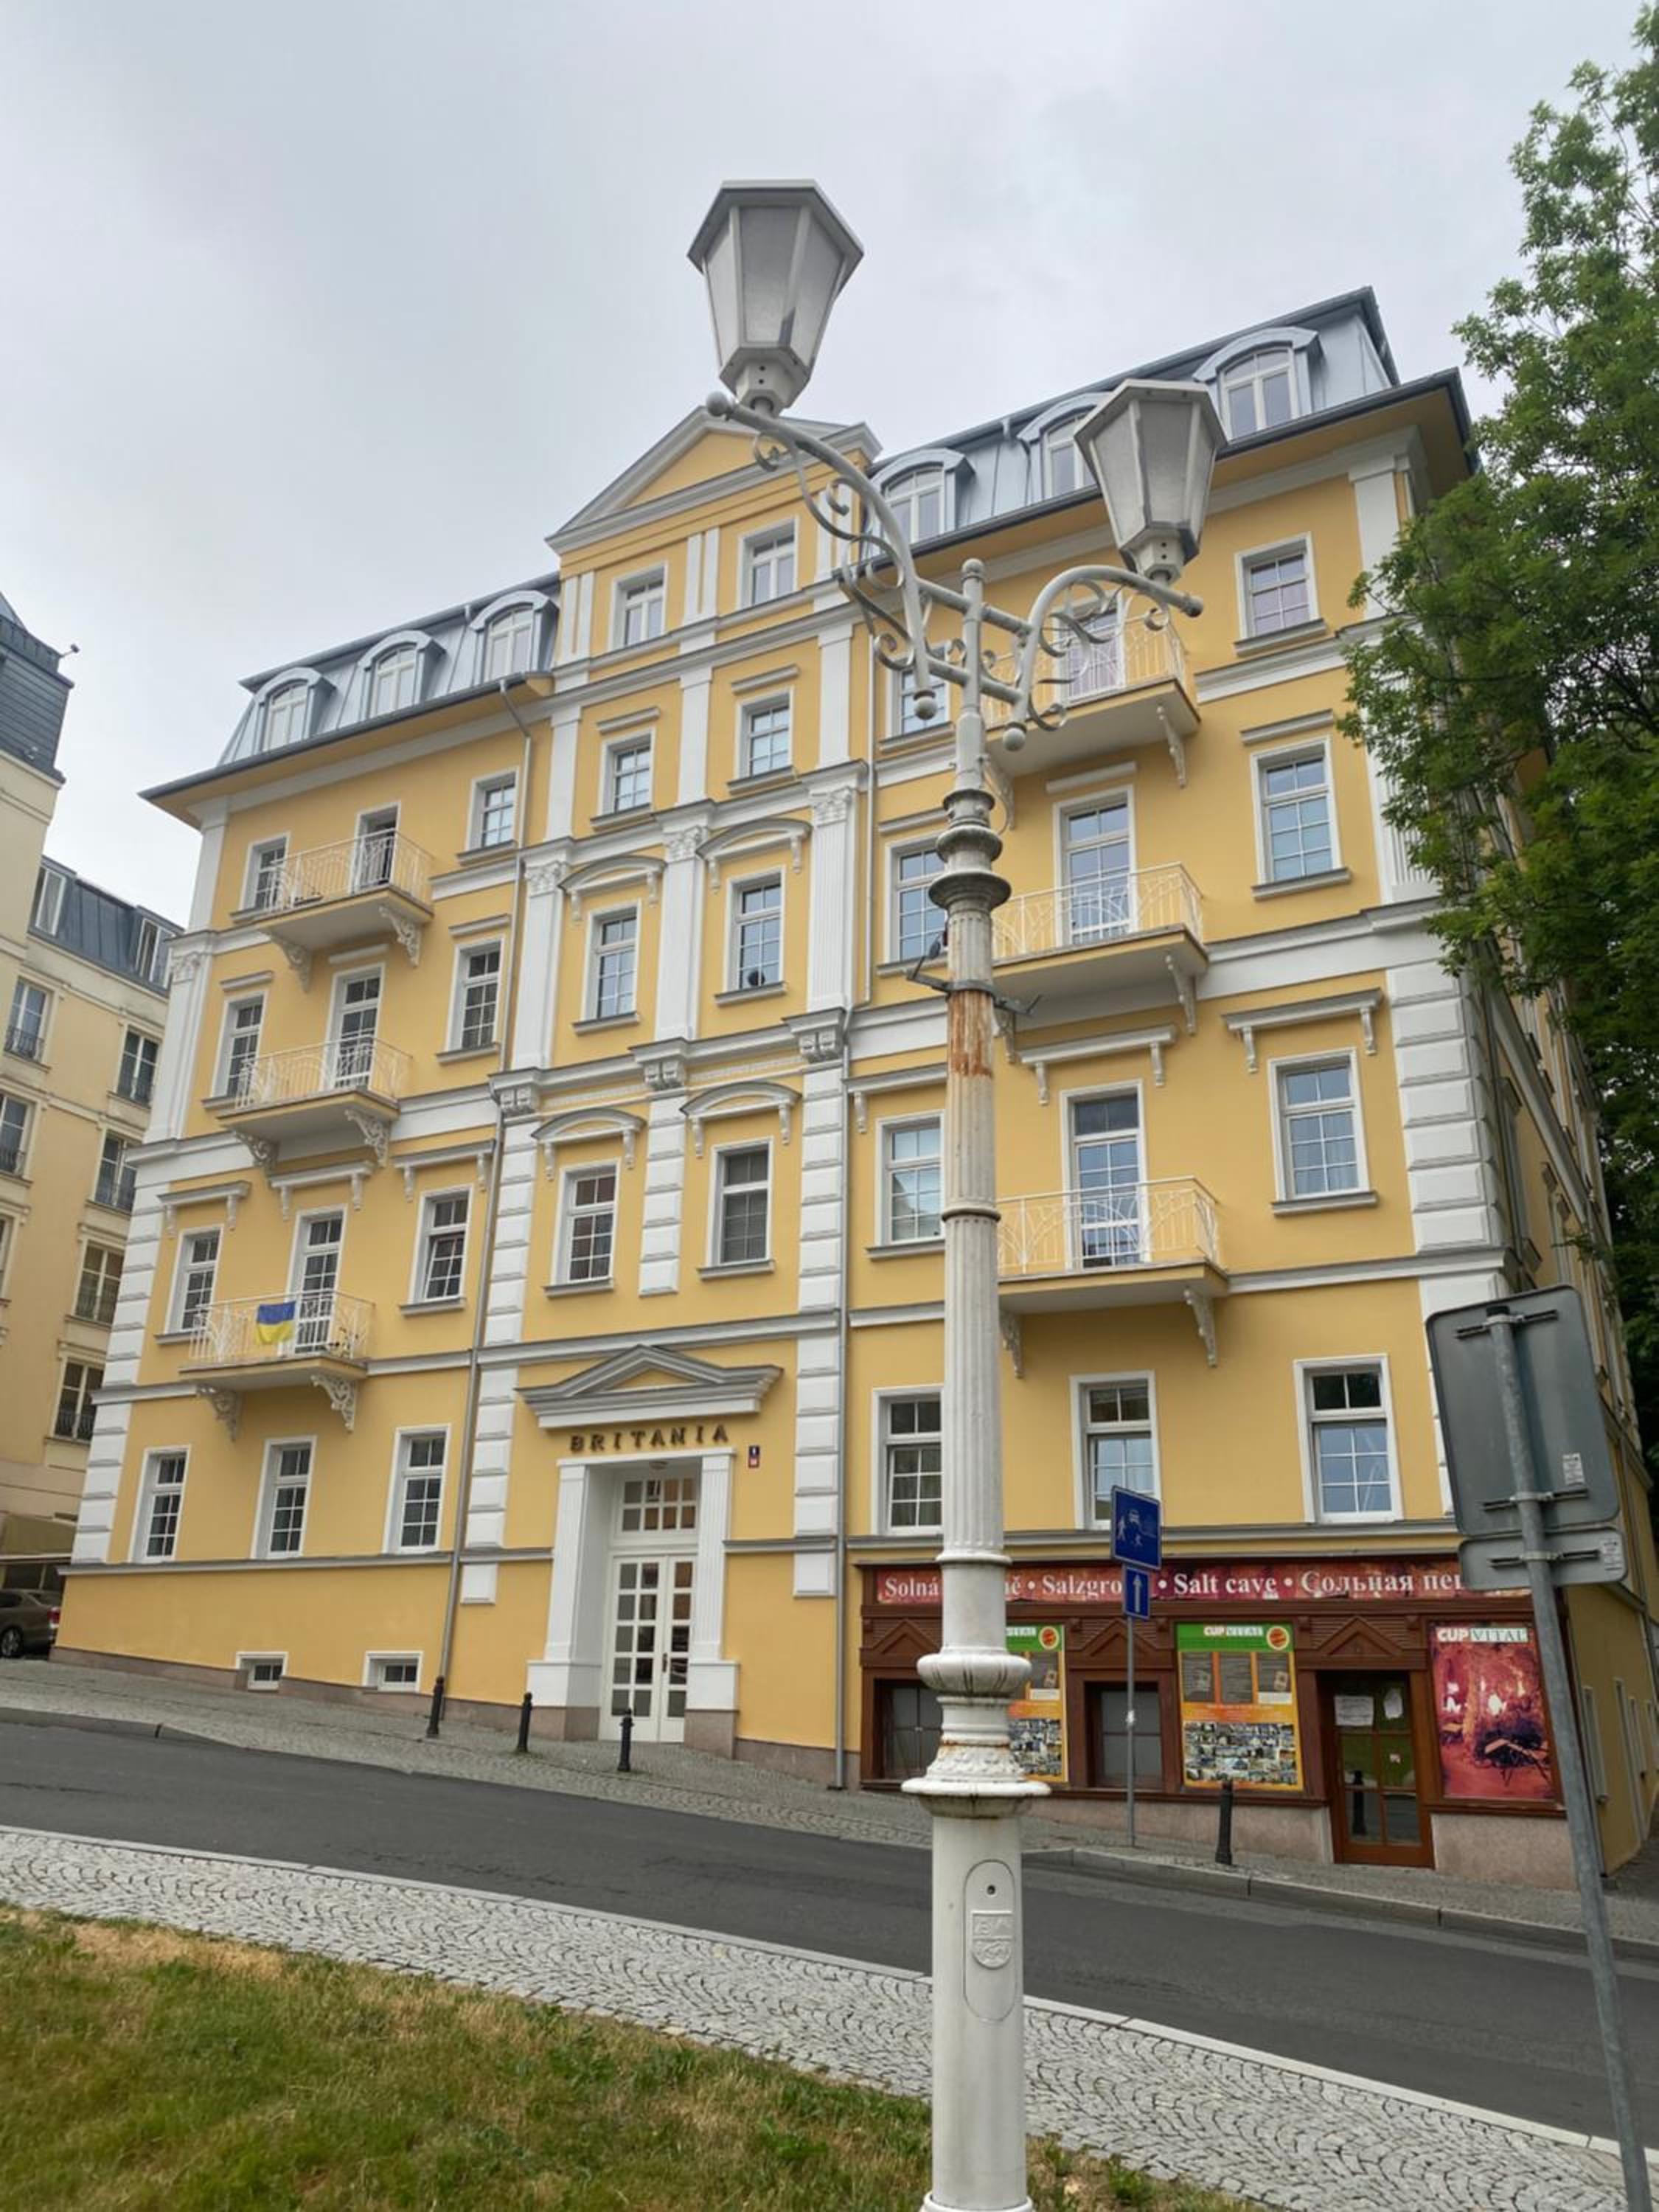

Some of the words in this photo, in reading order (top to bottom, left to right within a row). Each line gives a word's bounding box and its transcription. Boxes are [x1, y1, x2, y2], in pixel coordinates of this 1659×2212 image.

[571, 1425, 728, 1452] BRITANIA
[885, 1576, 941, 1598] Solná
[1041, 1573, 1123, 1599] Salzgro
[1173, 1573, 1219, 1595] Salt
[1225, 1577, 1278, 1594] cave
[1301, 1570, 1413, 1594] Сольная
[1436, 1627, 1469, 1642] CUP
[1470, 1627, 1528, 1643] VITAL
